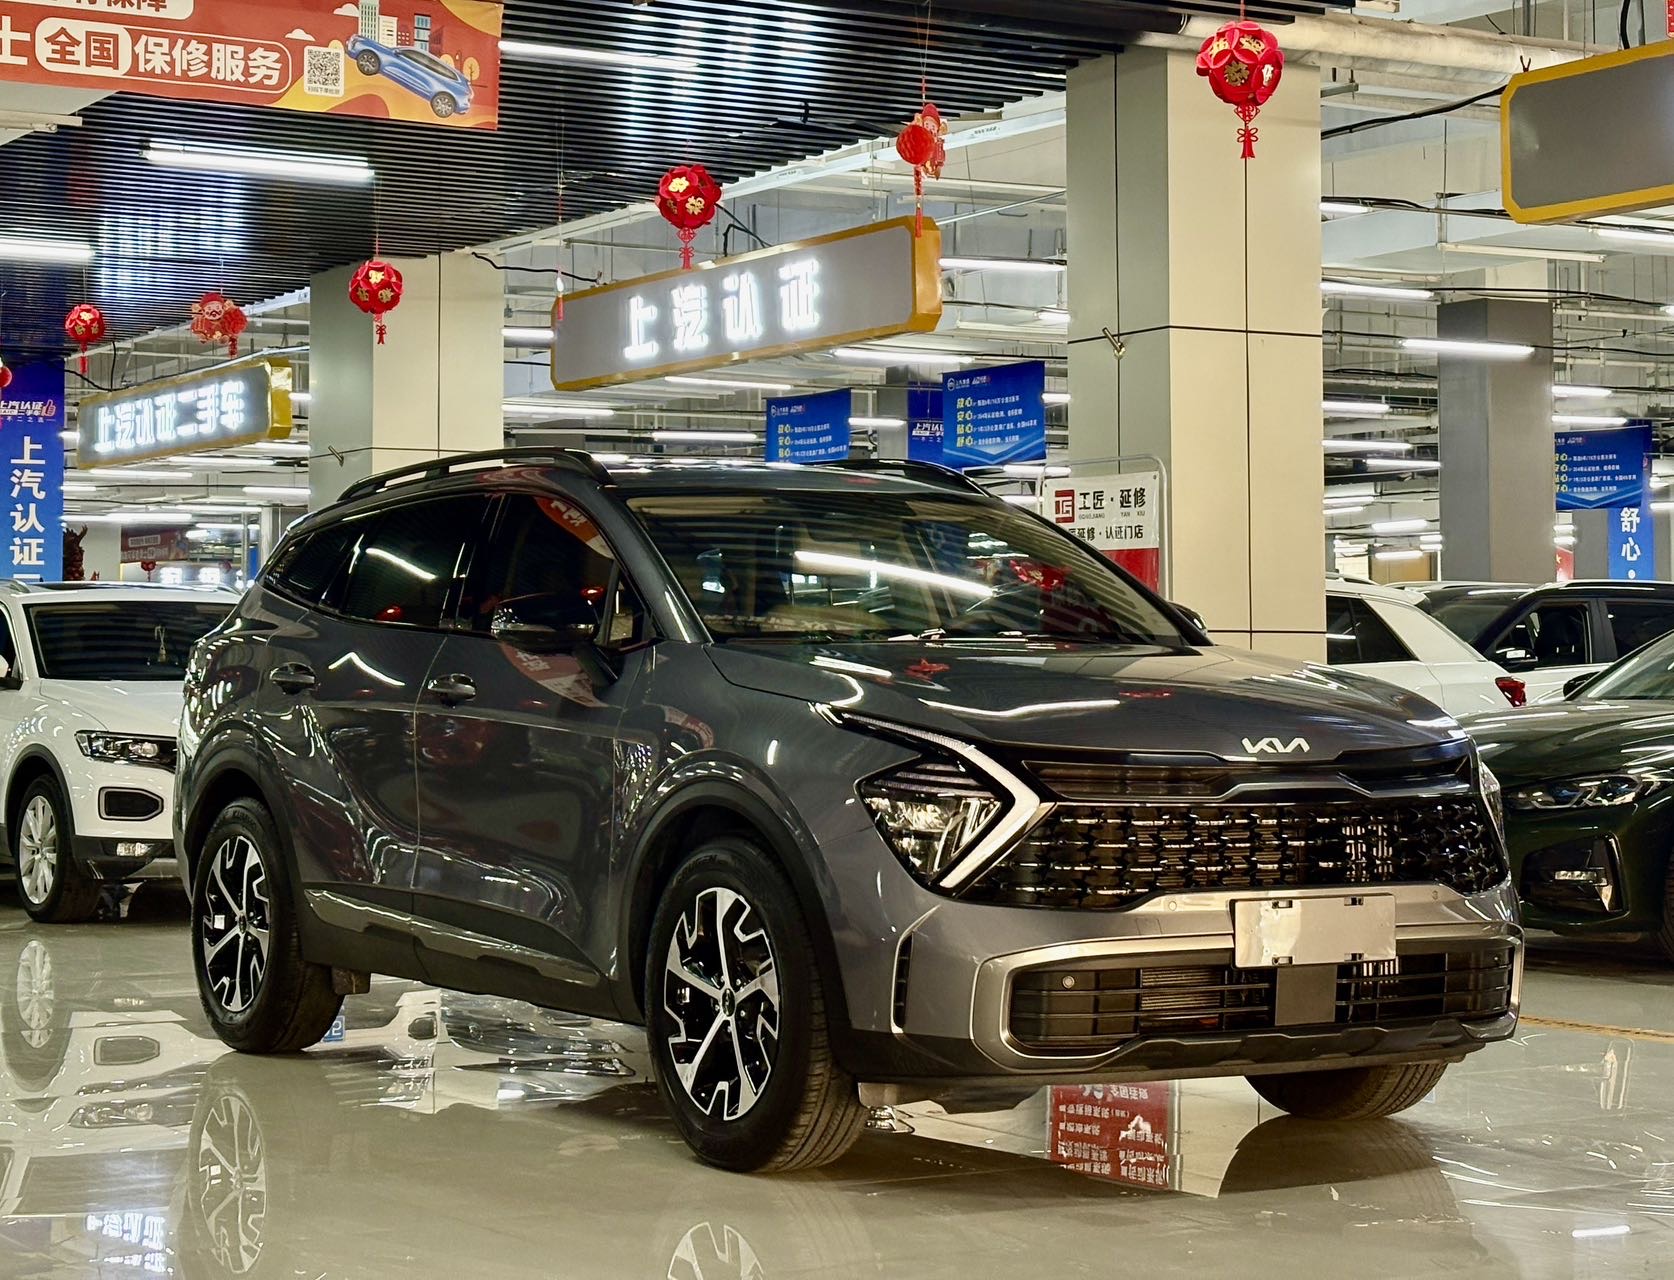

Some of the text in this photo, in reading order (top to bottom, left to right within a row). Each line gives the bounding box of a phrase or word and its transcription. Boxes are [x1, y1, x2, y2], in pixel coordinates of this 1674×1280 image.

[624, 258, 821, 360] 上汽认证
[94, 380, 246, 453] 上汽认证二手车
[1241, 737, 1311, 754] KIA
